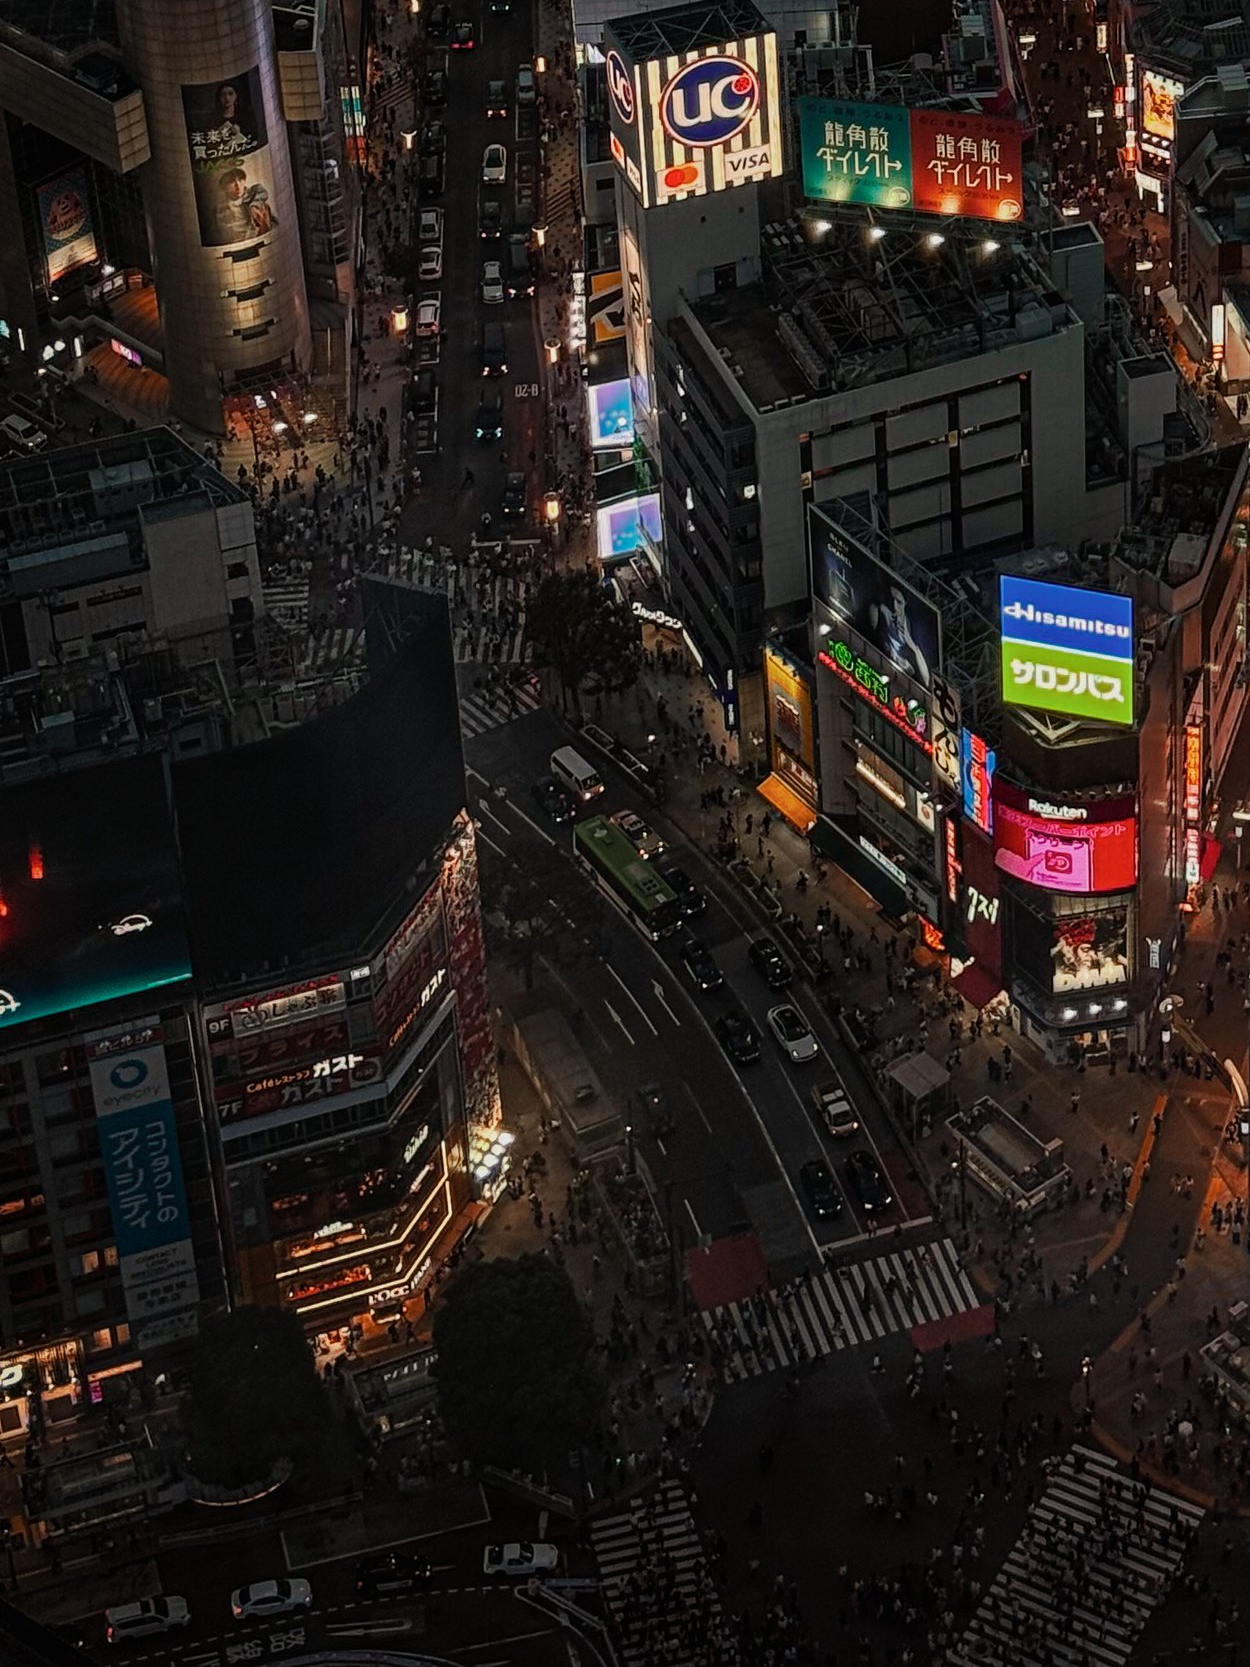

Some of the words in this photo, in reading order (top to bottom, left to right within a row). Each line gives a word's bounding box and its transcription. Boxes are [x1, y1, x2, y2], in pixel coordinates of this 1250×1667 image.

[192, 127, 232, 144] 未来を
[824, 120, 889, 152] 龍角散
[729, 152, 770, 172] VISA
[935, 134, 1001, 164] 龍角散
[1003, 601, 1130, 638] Hisamitsu
[1010, 658, 1125, 703] サロンパス
[1028, 798, 1087, 819] Rakuten
[208, 1018, 230, 1033] 9F
[313, 1053, 364, 1079] ガスト
[103, 1084, 161, 1107] eyecity
[218, 1100, 243, 1118] 7F
[108, 1128, 150, 1229] アイシティ
[147, 1120, 179, 1223] コンタクトの
